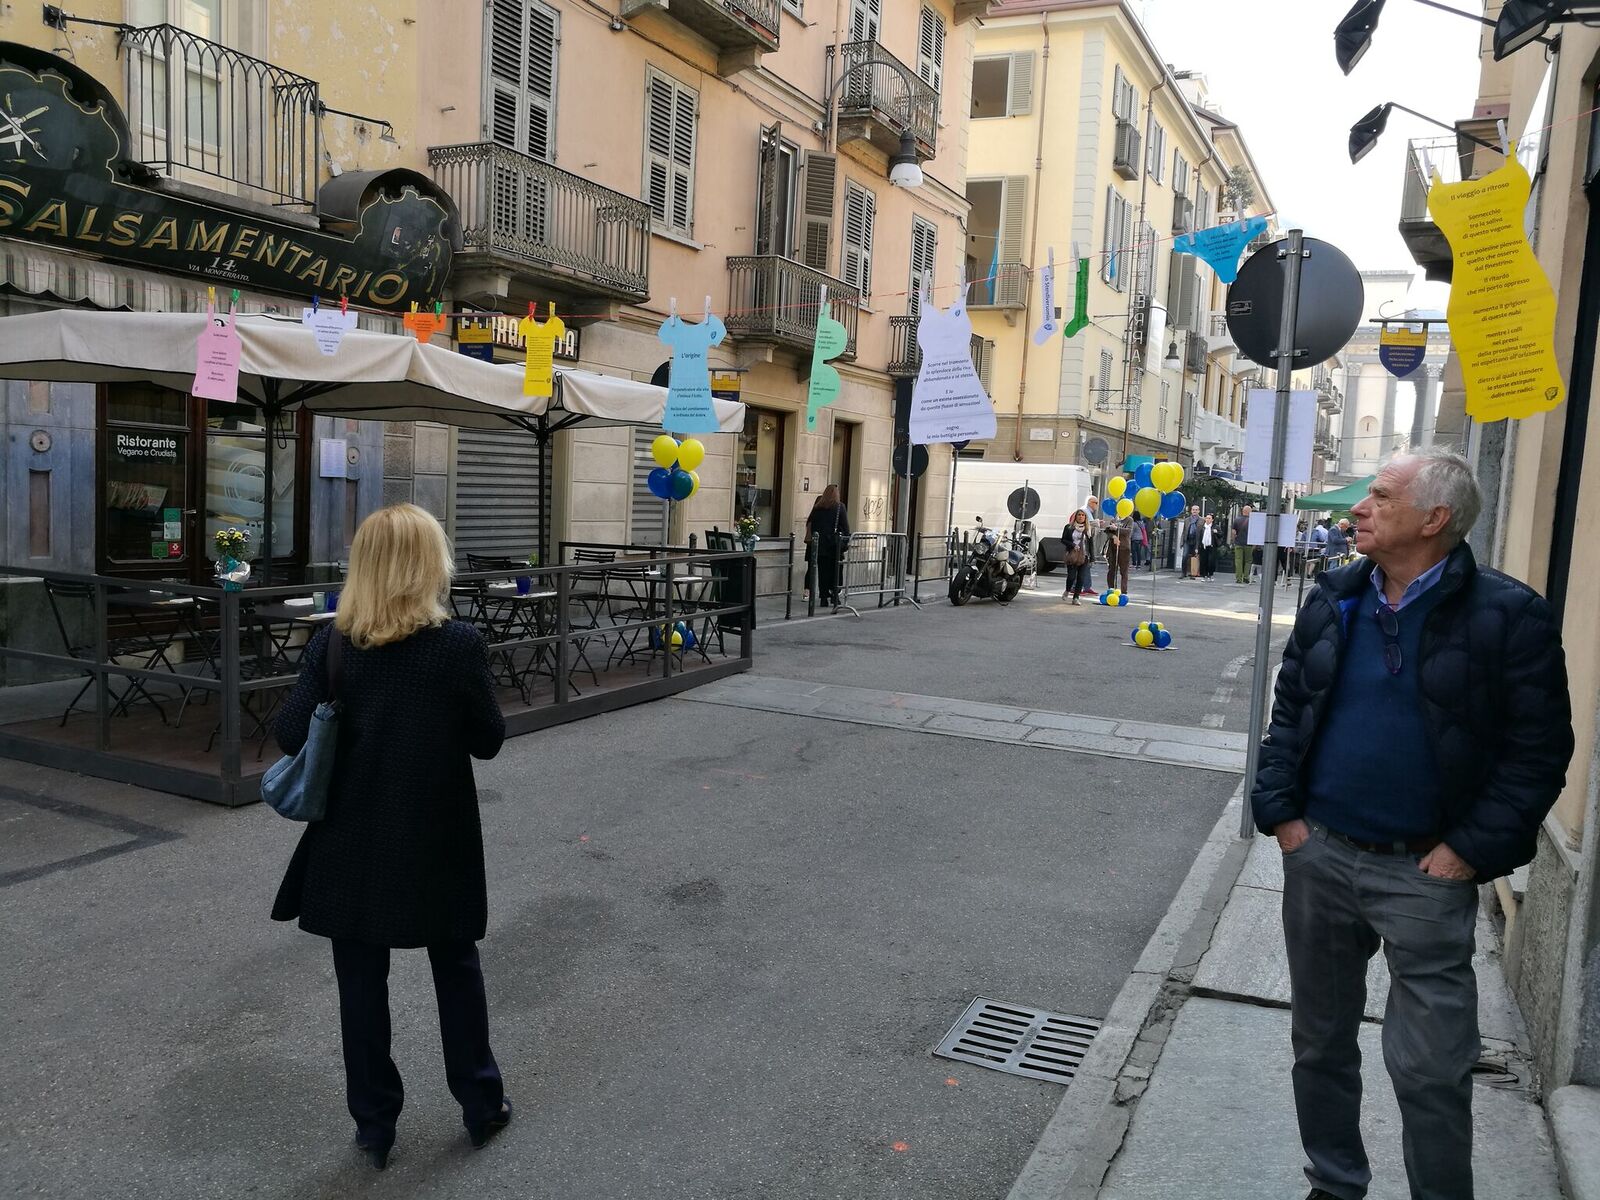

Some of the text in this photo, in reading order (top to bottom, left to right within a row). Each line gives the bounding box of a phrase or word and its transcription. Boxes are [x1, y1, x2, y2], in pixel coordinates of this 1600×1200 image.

[1457, 189, 1480, 199] viaggio
[1487, 183, 1509, 191] ritroso
[0, 178, 409, 305] SALSAMENTARIO
[188, 264, 200, 272] VIA
[117, 434, 177, 449] Ristorante
[117, 446, 143, 457] Vegano
[150, 449, 177, 458] Crudista
